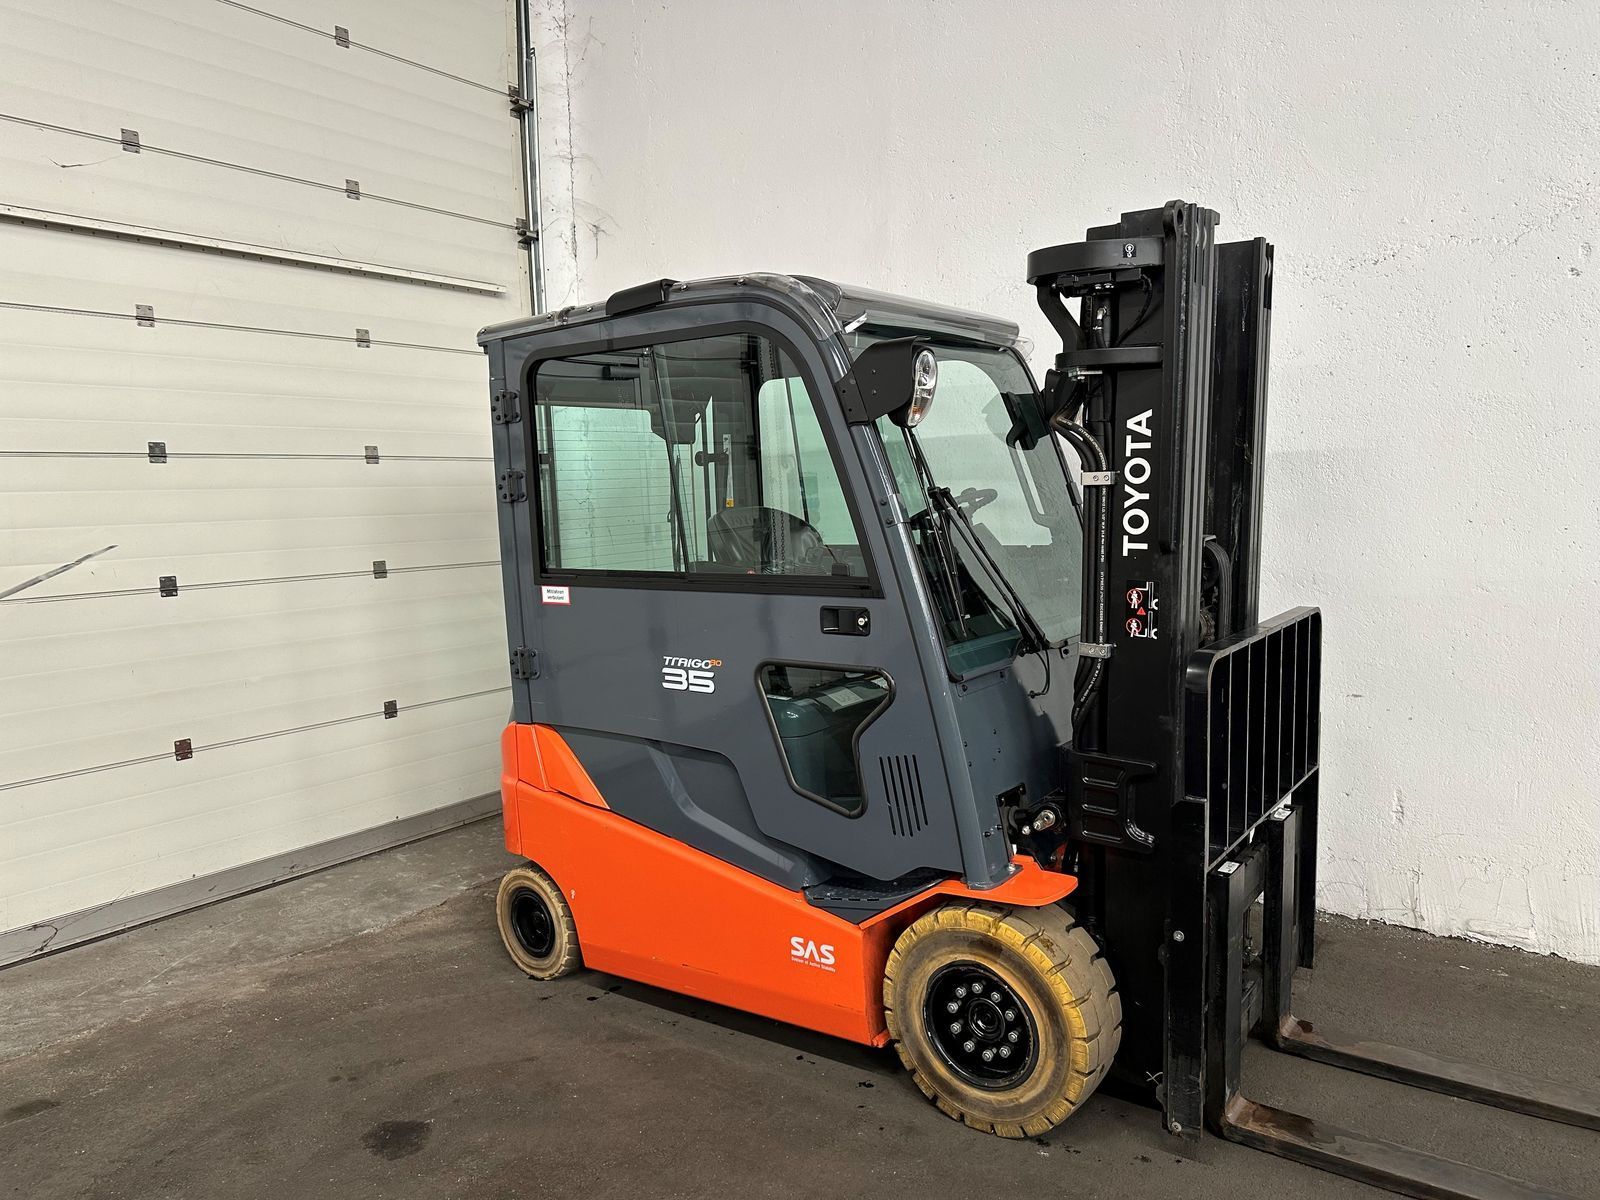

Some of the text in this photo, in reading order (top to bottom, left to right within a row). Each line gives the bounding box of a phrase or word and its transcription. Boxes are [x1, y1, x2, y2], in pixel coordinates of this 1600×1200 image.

[1122, 408, 1153, 557] TOYOTA
[661, 667, 715, 694] 35
[790, 936, 836, 965] SAS
